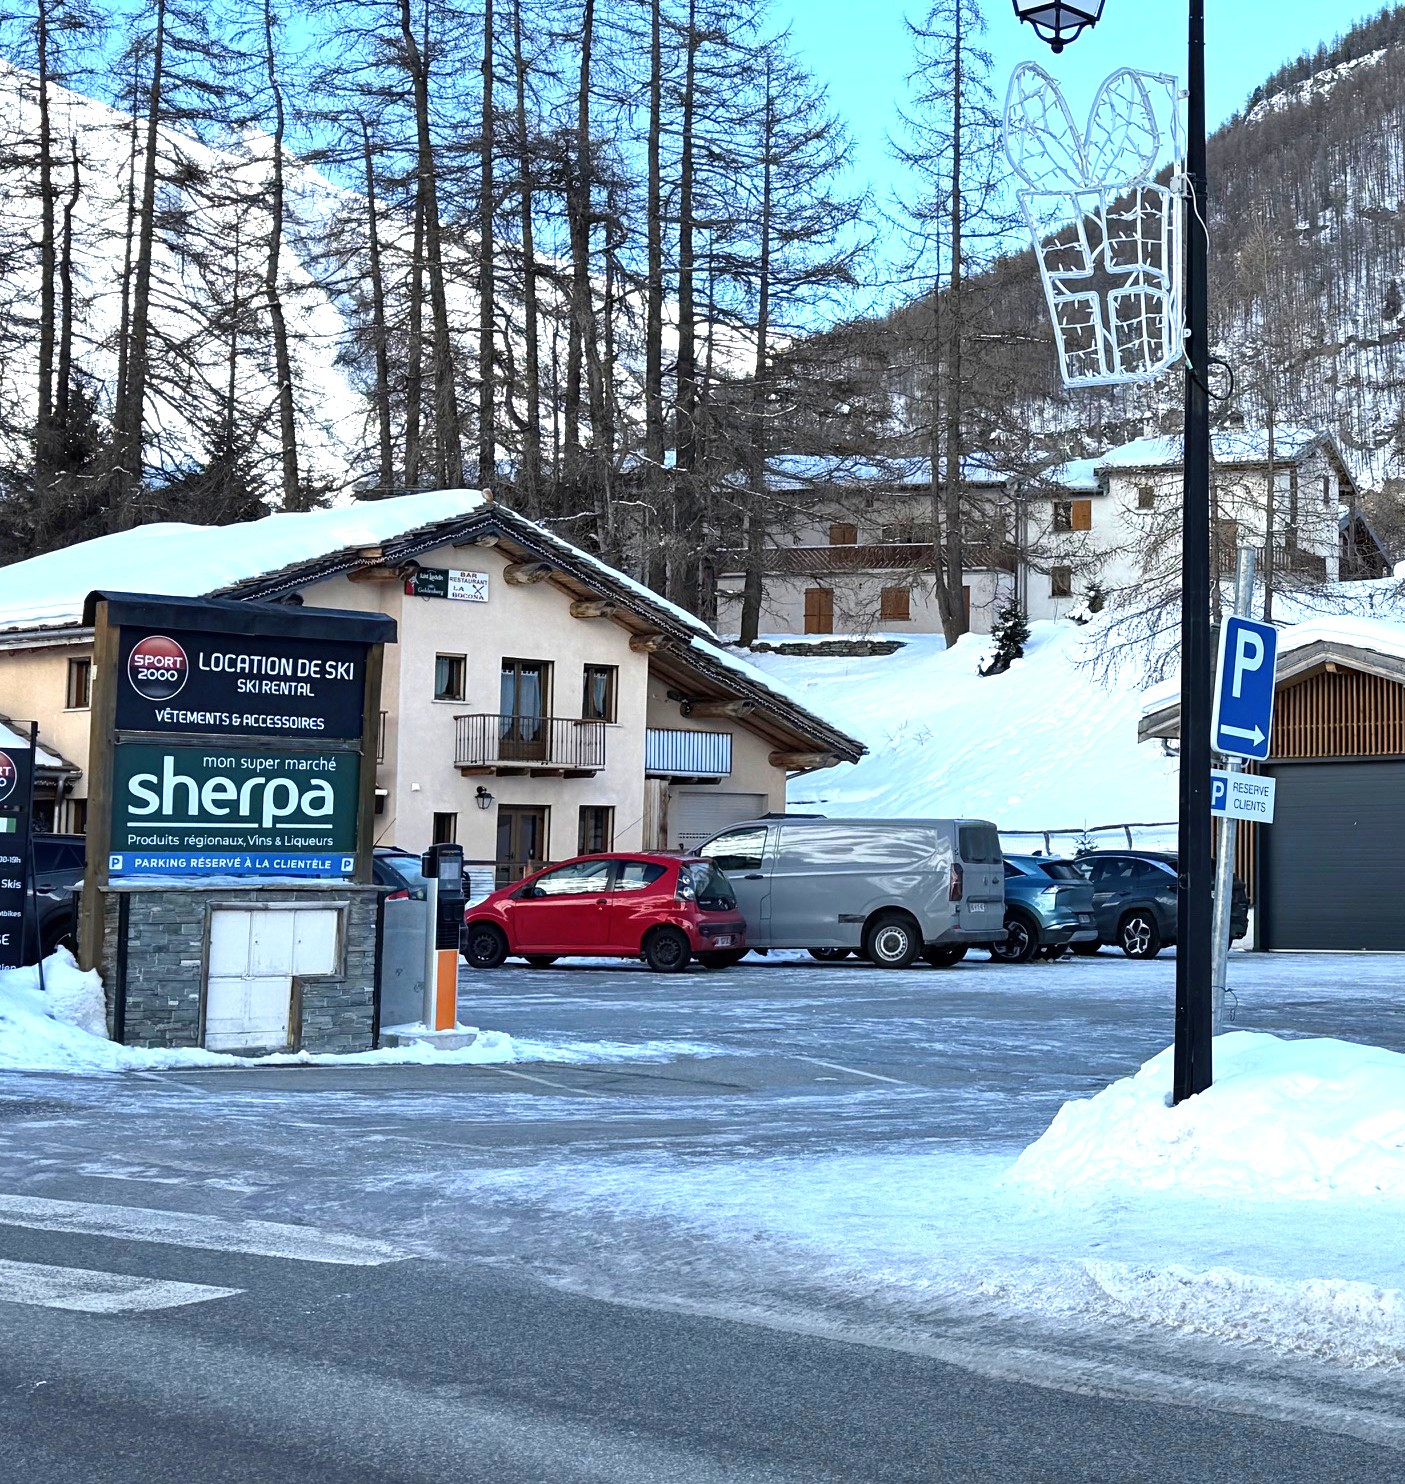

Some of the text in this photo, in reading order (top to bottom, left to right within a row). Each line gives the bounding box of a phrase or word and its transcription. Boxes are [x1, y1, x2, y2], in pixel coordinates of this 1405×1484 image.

[450, 577, 487, 585] RESTAURANT
[134, 654, 183, 669] SPORT
[198, 652, 355, 681] LOCATION DE SKI
[1231, 627, 1265, 699] P
[137, 668, 178, 681] 2000
[237, 679, 315, 697] SKI RENTAL
[155, 707, 325, 730] VÊTEMENTS & ACCESSOIRES
[202, 756, 337, 773] mon super marché
[127, 755, 335, 828] sherpa
[1211, 780, 1270, 806] P RESERVE
[1233, 798, 1267, 813] CLIENTS
[127, 834, 334, 849] Produits régionaux, Vins & Liqueurs
[111, 856, 352, 870] P PARKING RÉSERVÉ À LA CLIENTÈLE P
[1, 878, 22, 889] Skis
